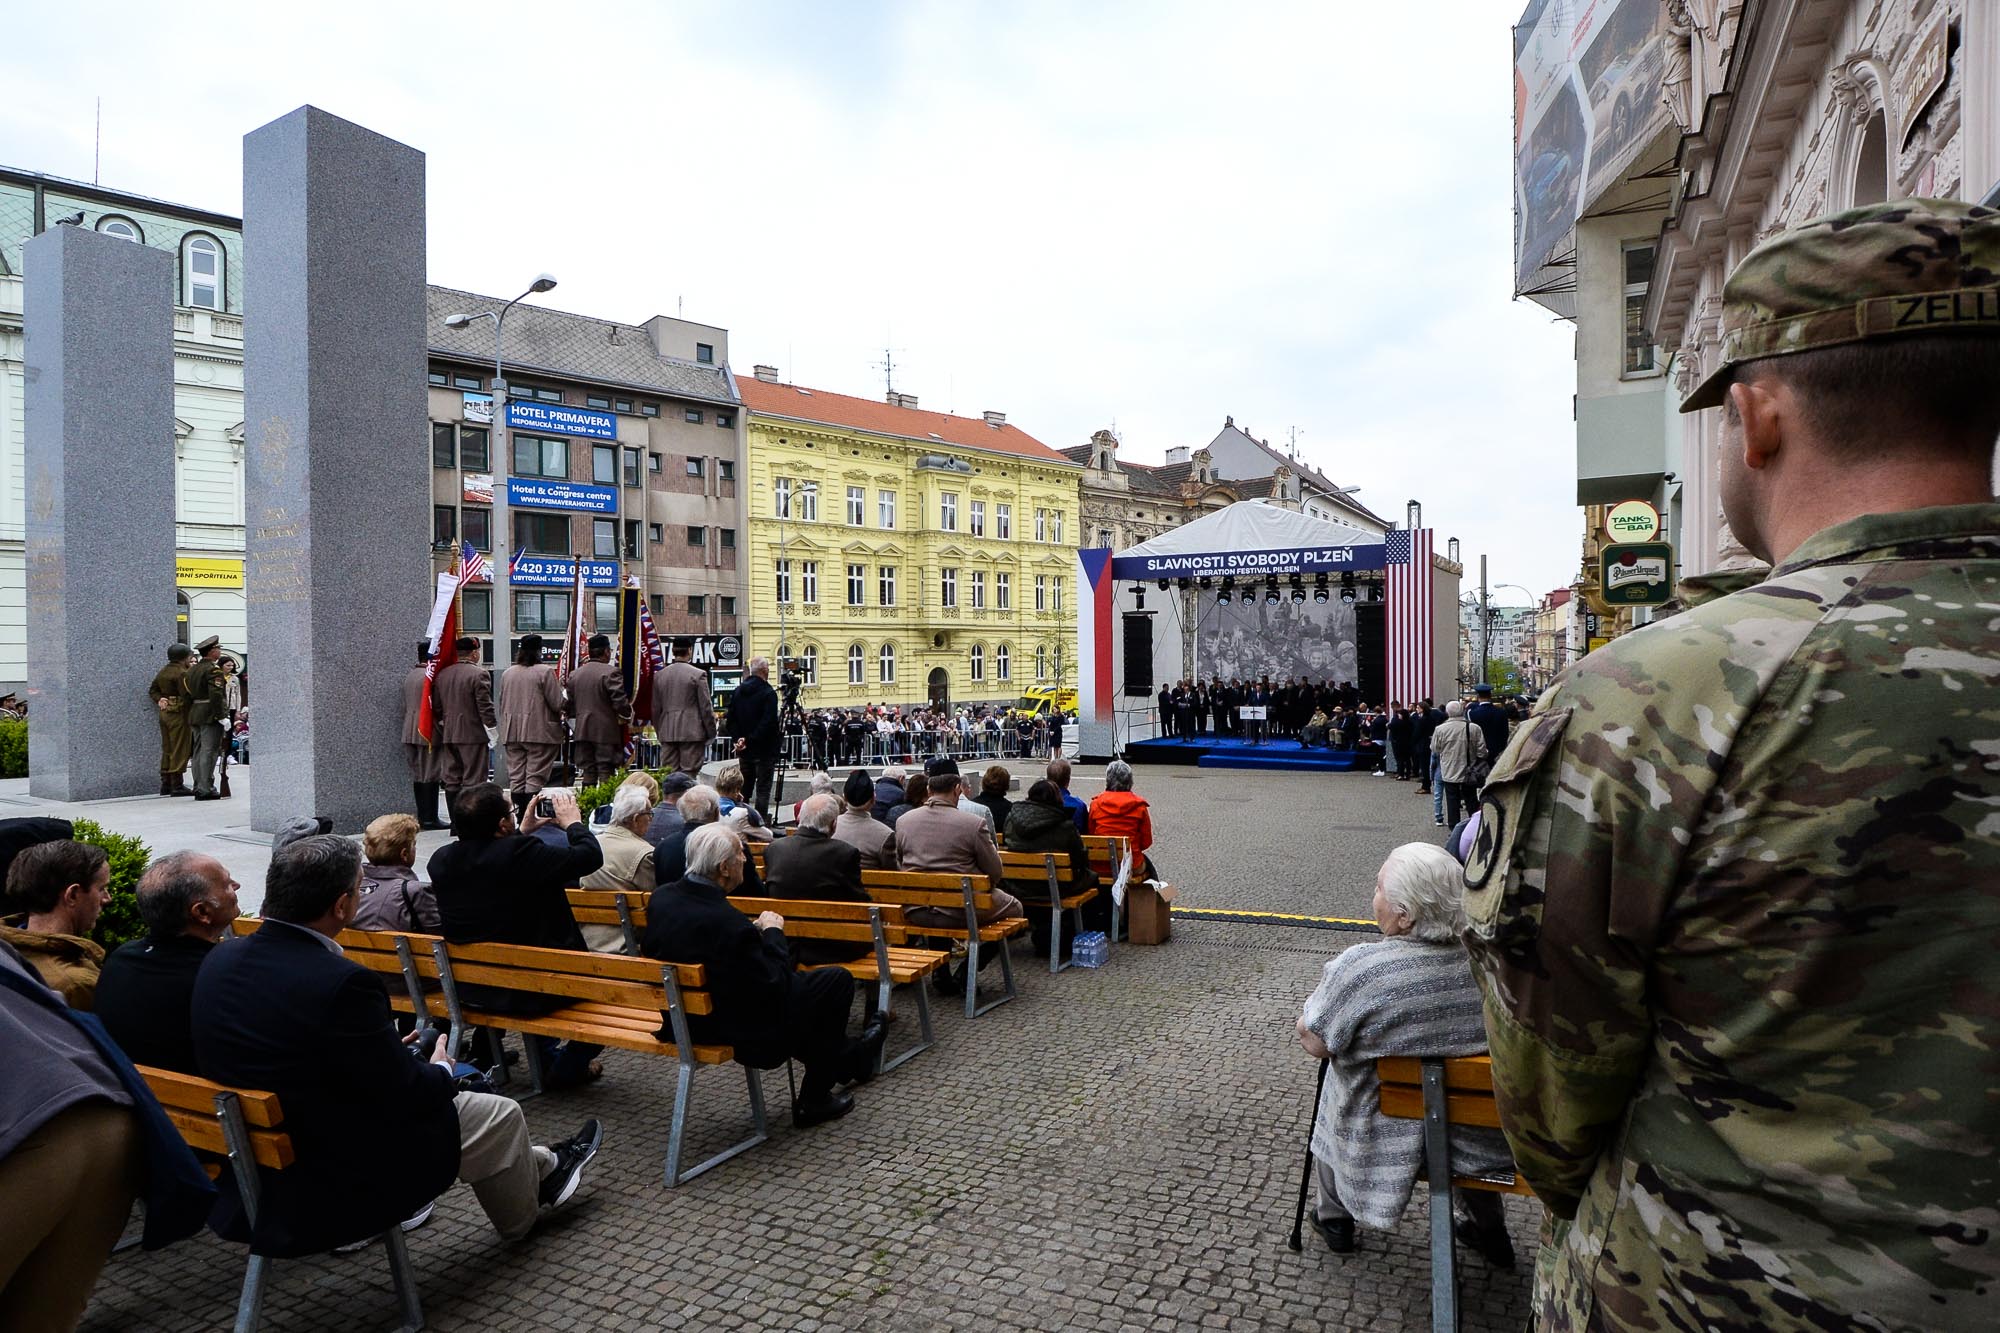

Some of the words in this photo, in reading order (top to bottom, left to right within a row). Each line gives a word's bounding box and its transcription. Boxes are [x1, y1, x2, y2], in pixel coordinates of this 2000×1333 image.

[1896, 292, 2000, 327] ZELL
[511, 406, 547, 419] HOTEL
[549, 411, 611, 428] PRIMAVERA
[511, 418, 552, 429] NEPOMUCKÁ
[512, 485, 535, 494] Hotel
[537, 487, 546, 495] &
[547, 488, 584, 499] Congress
[586, 493, 611, 501] centre
[520, 496, 605, 509] WWW.PRIMAVERAHOTEL.CZ
[1147, 556, 1224, 571] SLAVNOSTI
[1227, 553, 1300, 568] SVOBODY
[1303, 547, 1353, 564] PLZEŇ
[546, 564, 566, 575] 378
[592, 566, 613, 576] 500
[1193, 568, 1235, 576] LIBERATION
[1613, 566, 1636, 581] Pilsner
[1636, 565, 1660, 576] Urquell
[1587, 616, 1595, 632] CLUB
[660, 638, 716, 664] TAÁK
